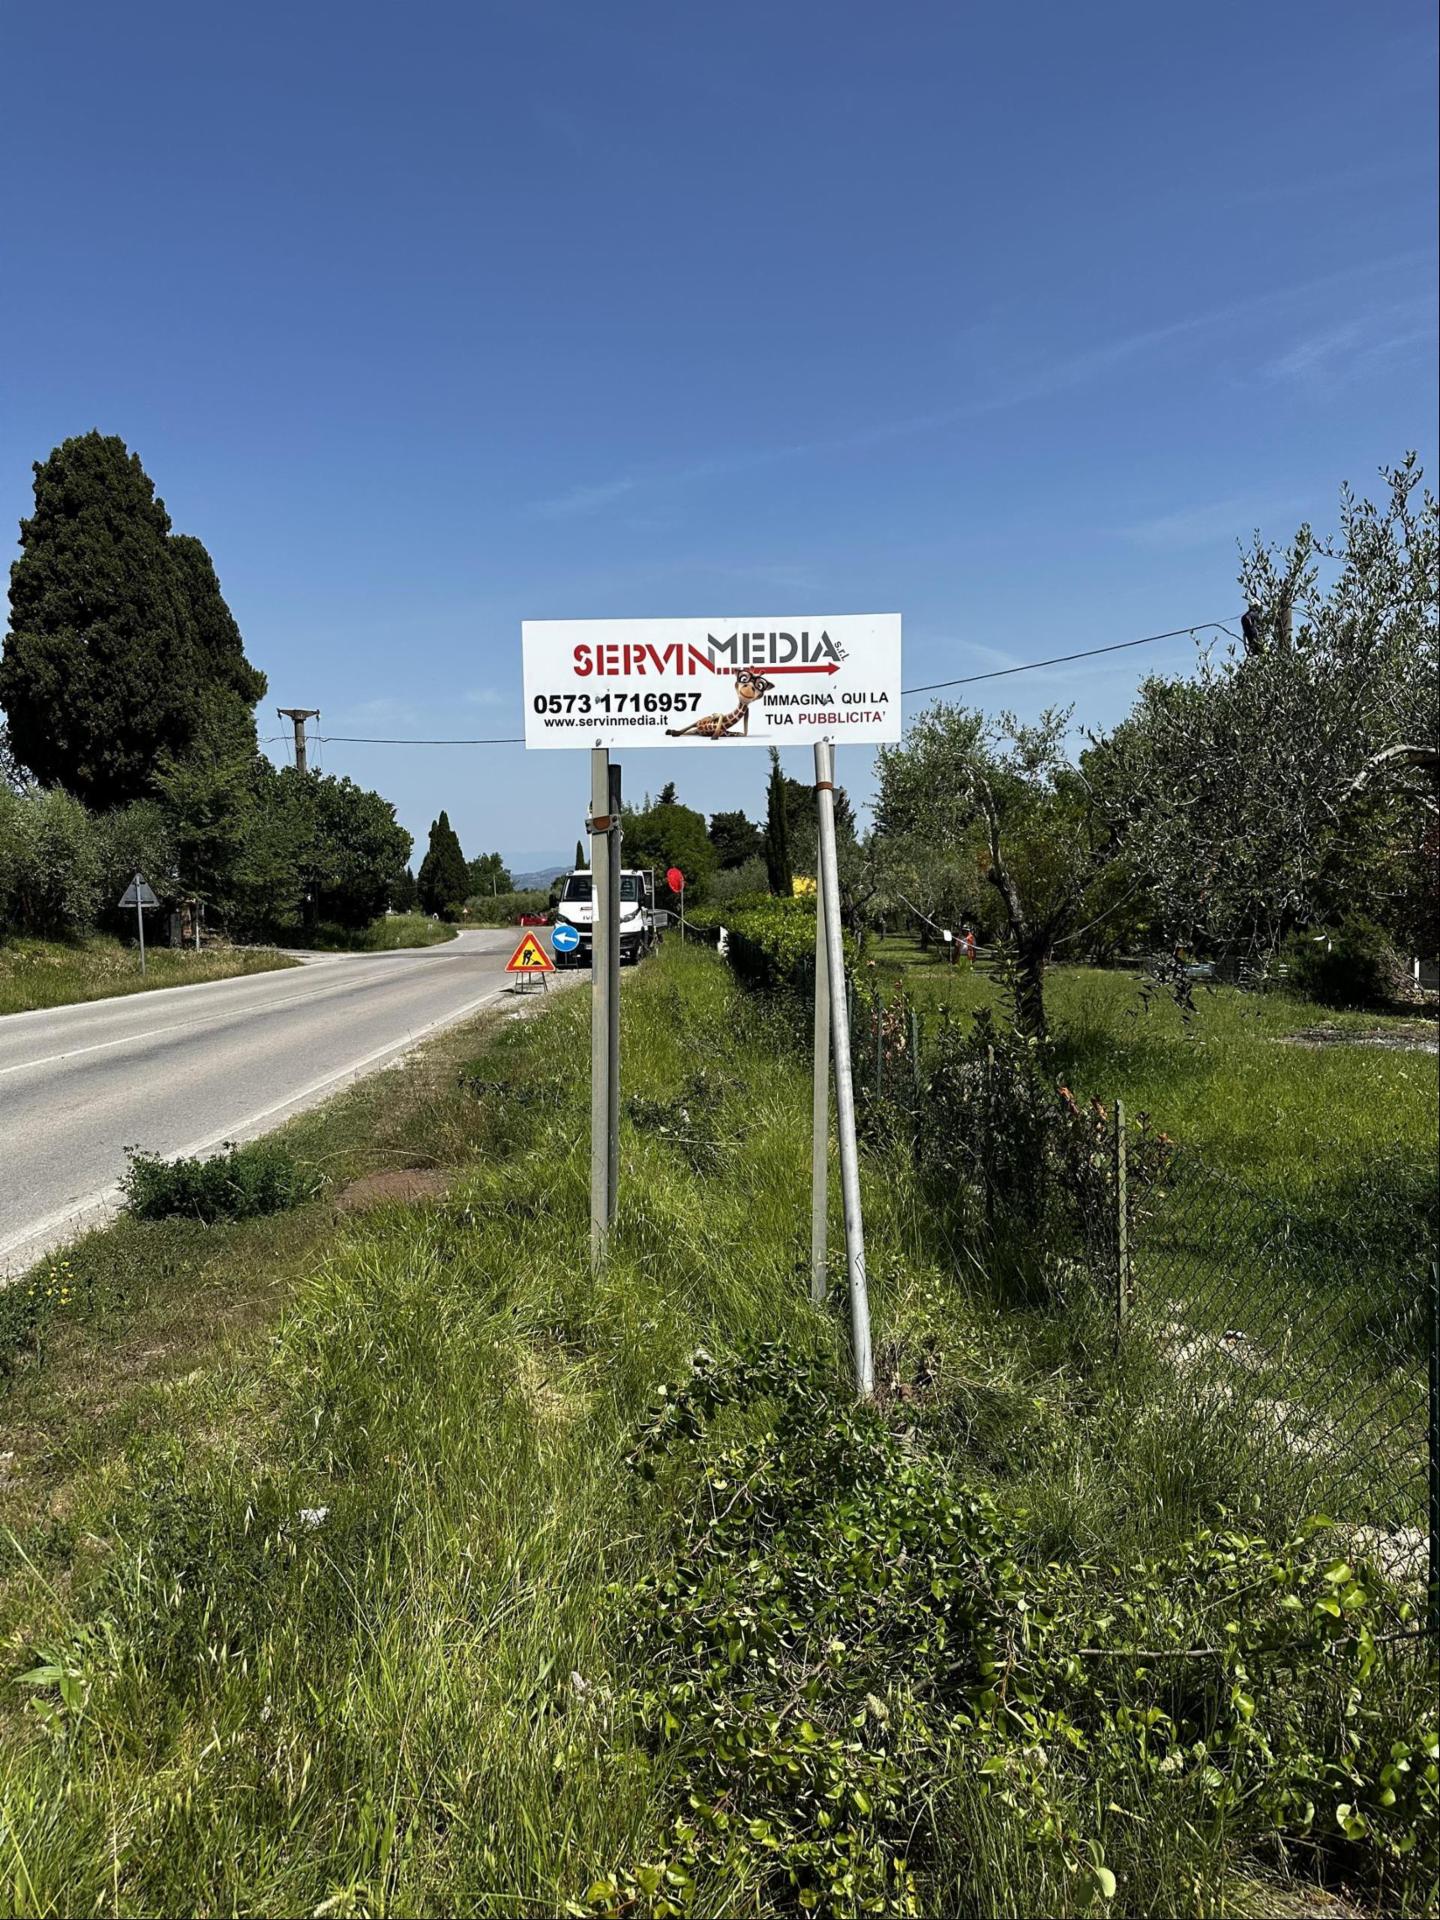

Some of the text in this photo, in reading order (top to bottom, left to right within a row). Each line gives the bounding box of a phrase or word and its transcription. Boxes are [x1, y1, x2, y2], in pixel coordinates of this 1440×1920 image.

[533, 693, 702, 714] 0573 1716957
[763, 692, 889, 706] IMMAGINA QUI LA
[544, 714, 669, 727] www.servinmedia.it
[765, 711, 886, 725] TUA PUBBLICITA'
